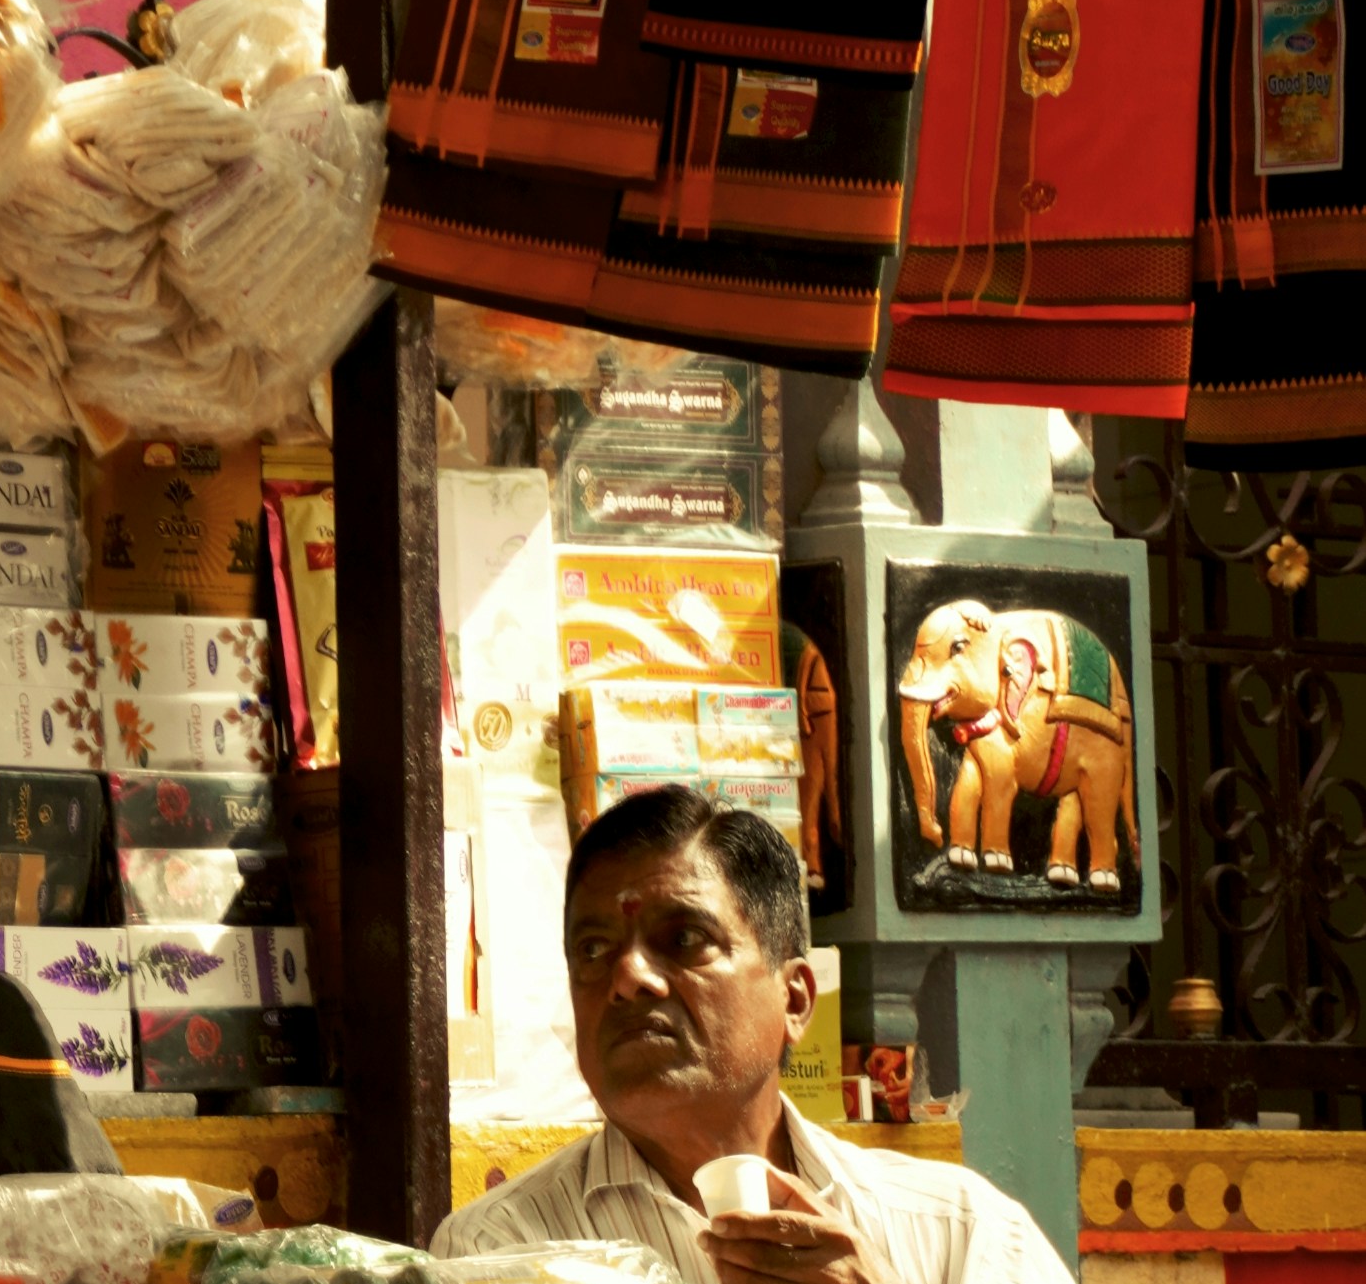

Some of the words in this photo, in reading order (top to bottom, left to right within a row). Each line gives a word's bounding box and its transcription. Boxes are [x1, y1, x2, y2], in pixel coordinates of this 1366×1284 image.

[1267, 72, 1302, 96] Good
[1306, 71, 1331, 98] Day
[599, 385, 668, 411] Sugandha
[668, 389, 724, 414] Swarna
[602, 489, 671, 515] Sugandha
[671, 493, 725, 517] Swarna
[185, 623, 198, 690] CHAMPA
[18, 692, 33, 759] CHAMPA
[12, 933, 23, 978] ENDER
[235, 933, 252, 1000] LAVENDER
[780, 1059, 825, 1079] asturi
